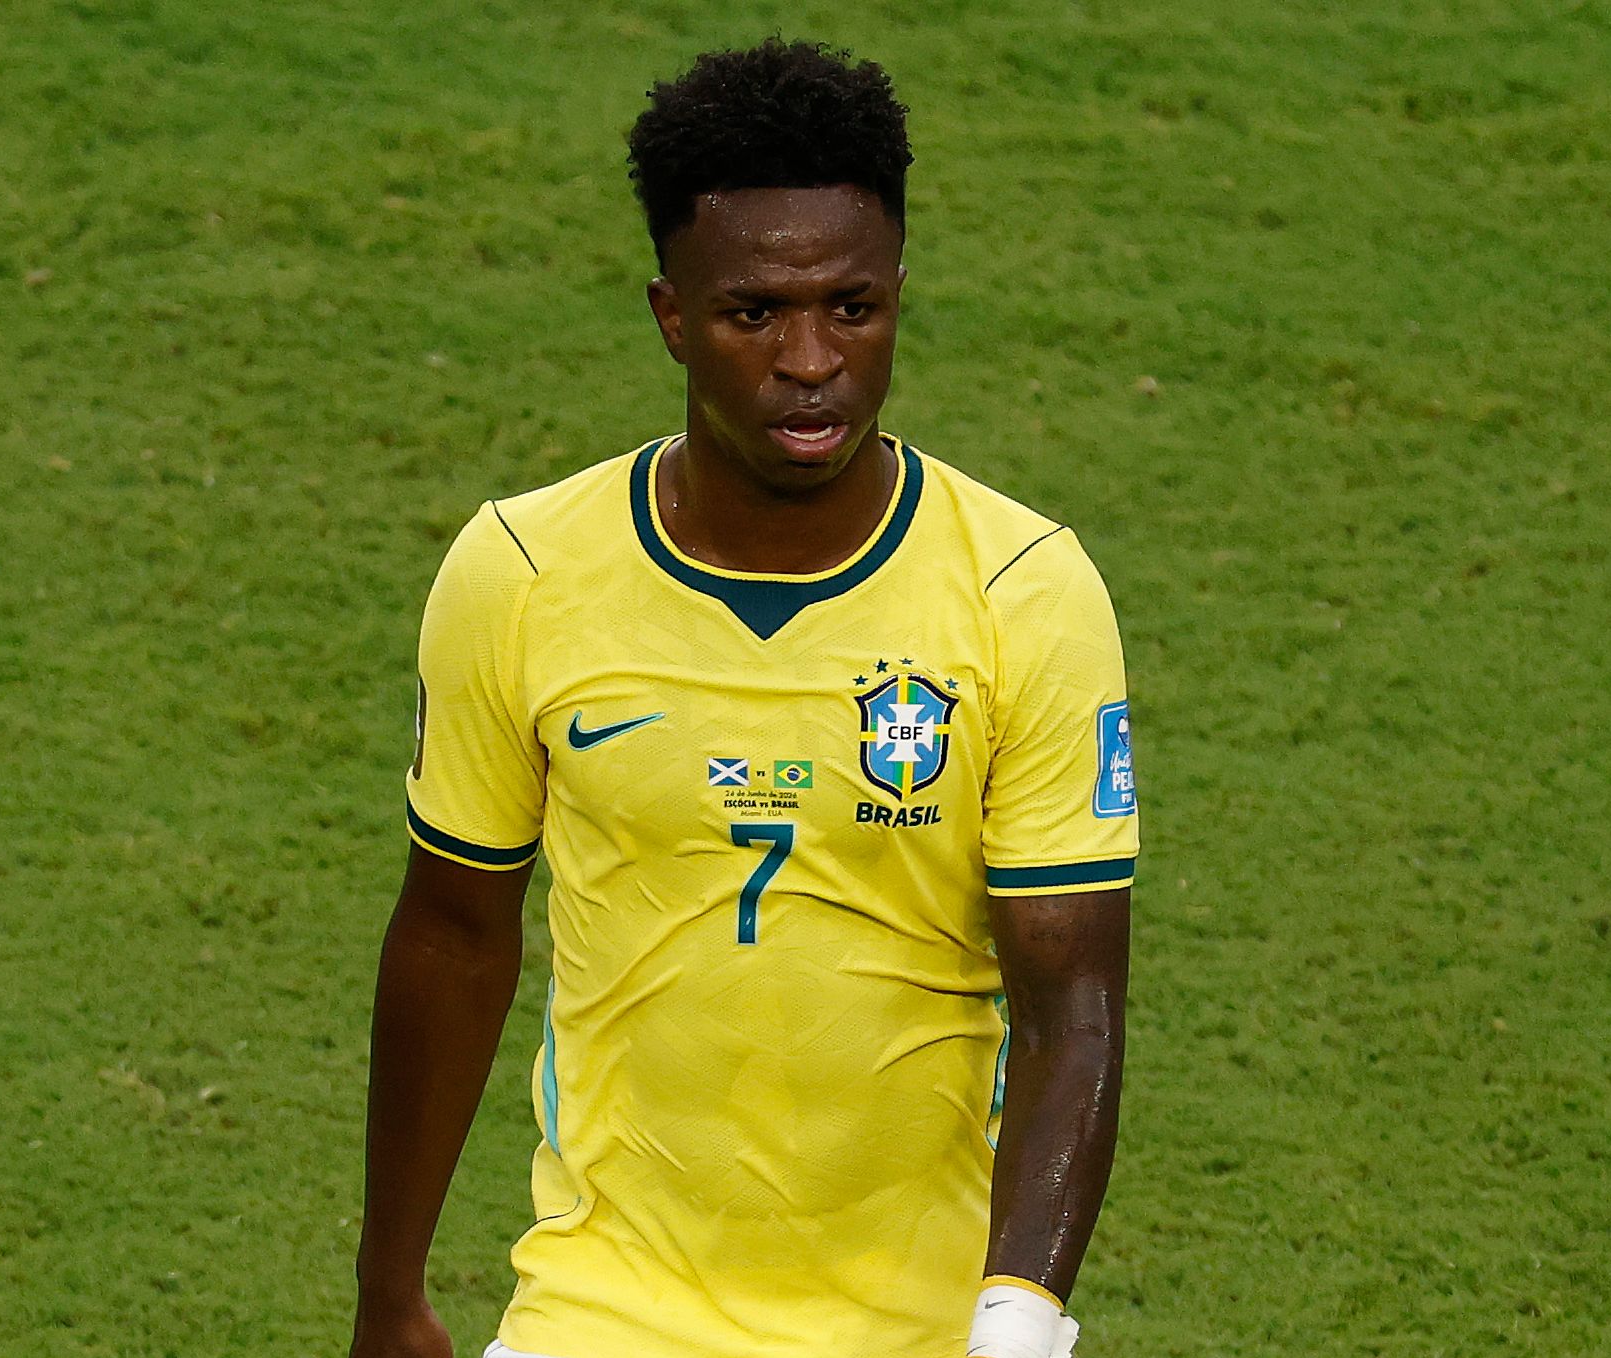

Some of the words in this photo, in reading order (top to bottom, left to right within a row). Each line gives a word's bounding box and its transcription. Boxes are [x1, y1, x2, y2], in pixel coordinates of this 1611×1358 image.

[887, 725, 924, 741] CBF
[771, 799, 800, 809] BRASIL
[855, 802, 942, 828] BRASIL
[730, 823, 795, 945] 7
